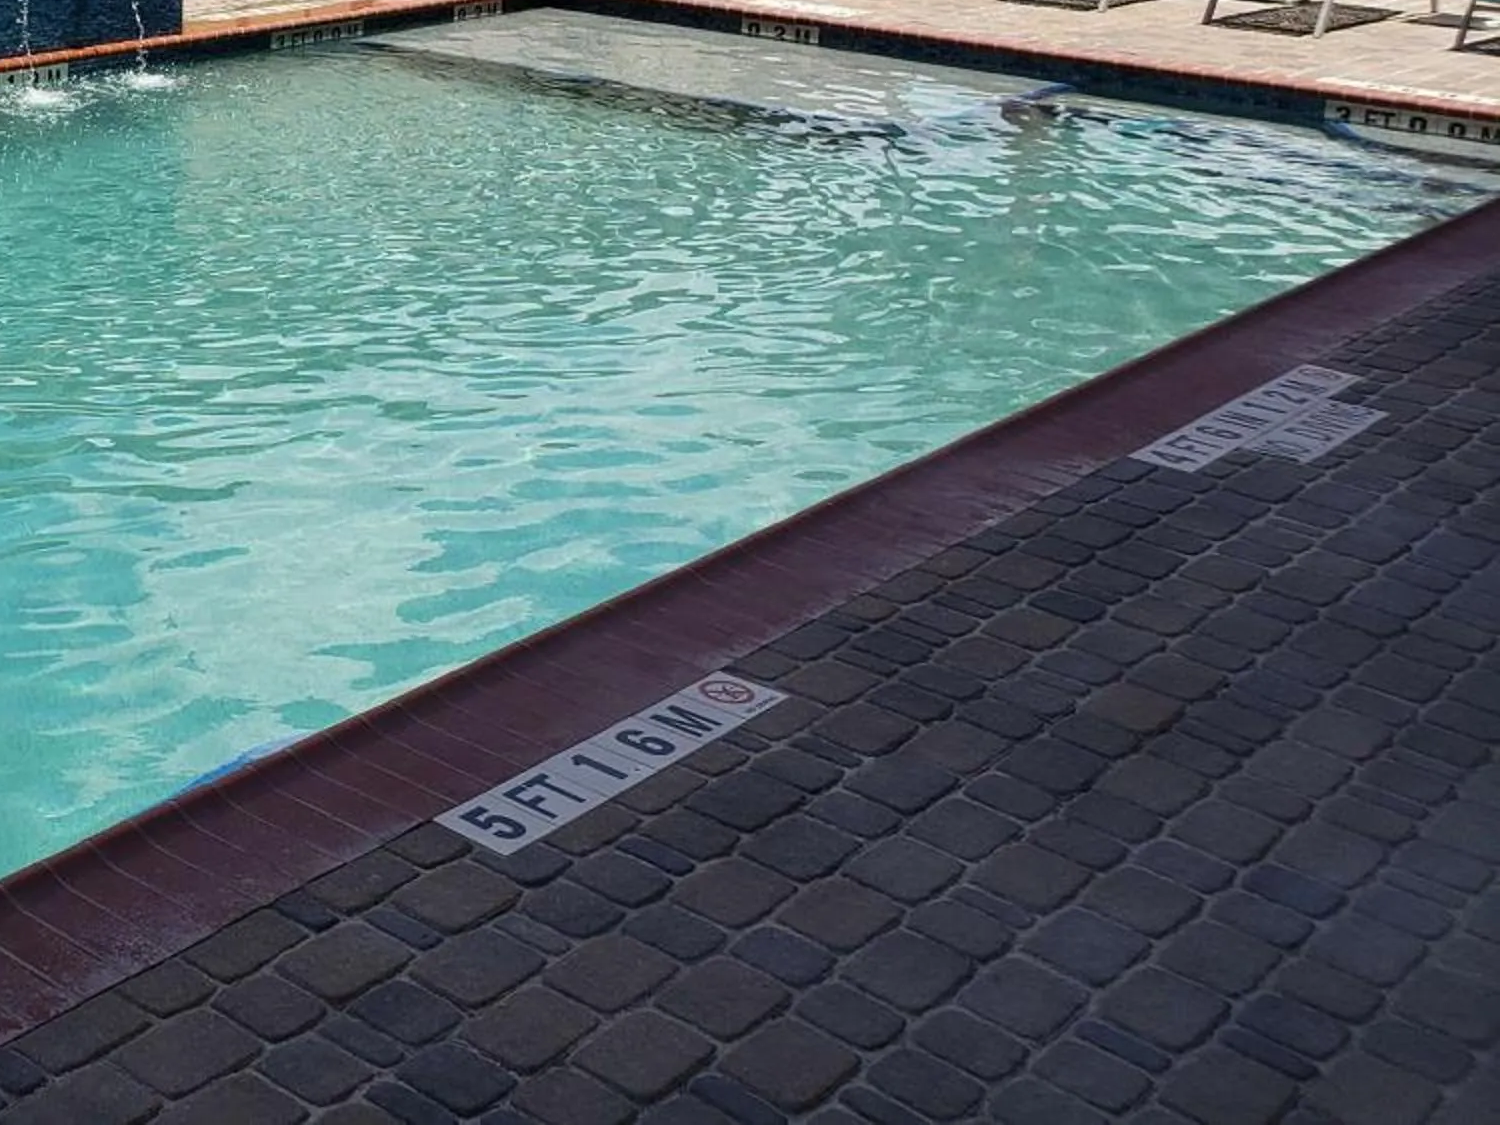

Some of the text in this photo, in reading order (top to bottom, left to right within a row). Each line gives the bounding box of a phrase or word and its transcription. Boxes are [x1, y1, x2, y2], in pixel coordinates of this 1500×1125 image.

[1150, 379, 1329, 466] 4 FT 6 IN 1 2 M
[1283, 402, 1376, 442] DIVING
[459, 806, 527, 839] 5
[502, 773, 587, 820] FT
[571, 753, 629, 780] 1
[615, 729, 677, 756] 6
[650, 704, 723, 738] M
